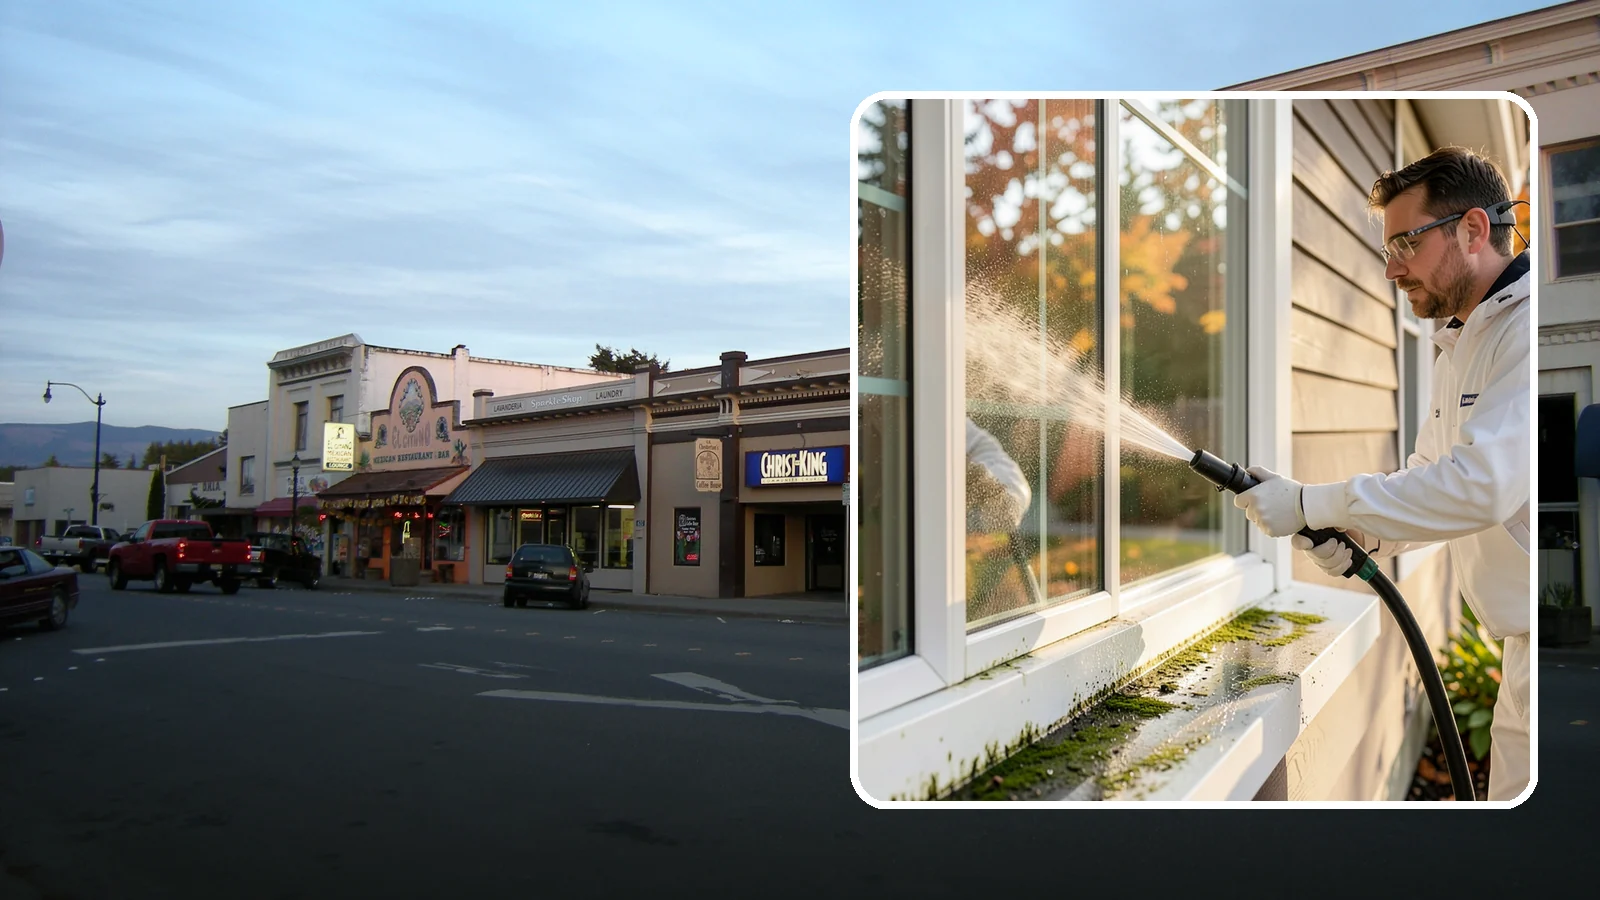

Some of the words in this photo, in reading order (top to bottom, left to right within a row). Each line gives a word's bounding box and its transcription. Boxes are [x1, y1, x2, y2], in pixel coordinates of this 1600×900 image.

[494, 402, 522, 412] LAVANDERIA
[561, 394, 582, 404] Shop
[595, 389, 623, 400] LAUNDRY
[373, 454, 396, 464] MEXICAN
[397, 451, 433, 462] RESTAURANT
[438, 450, 450, 459] BAR
[761, 452, 797, 477] CHRIST
[799, 450, 827, 476] KING
